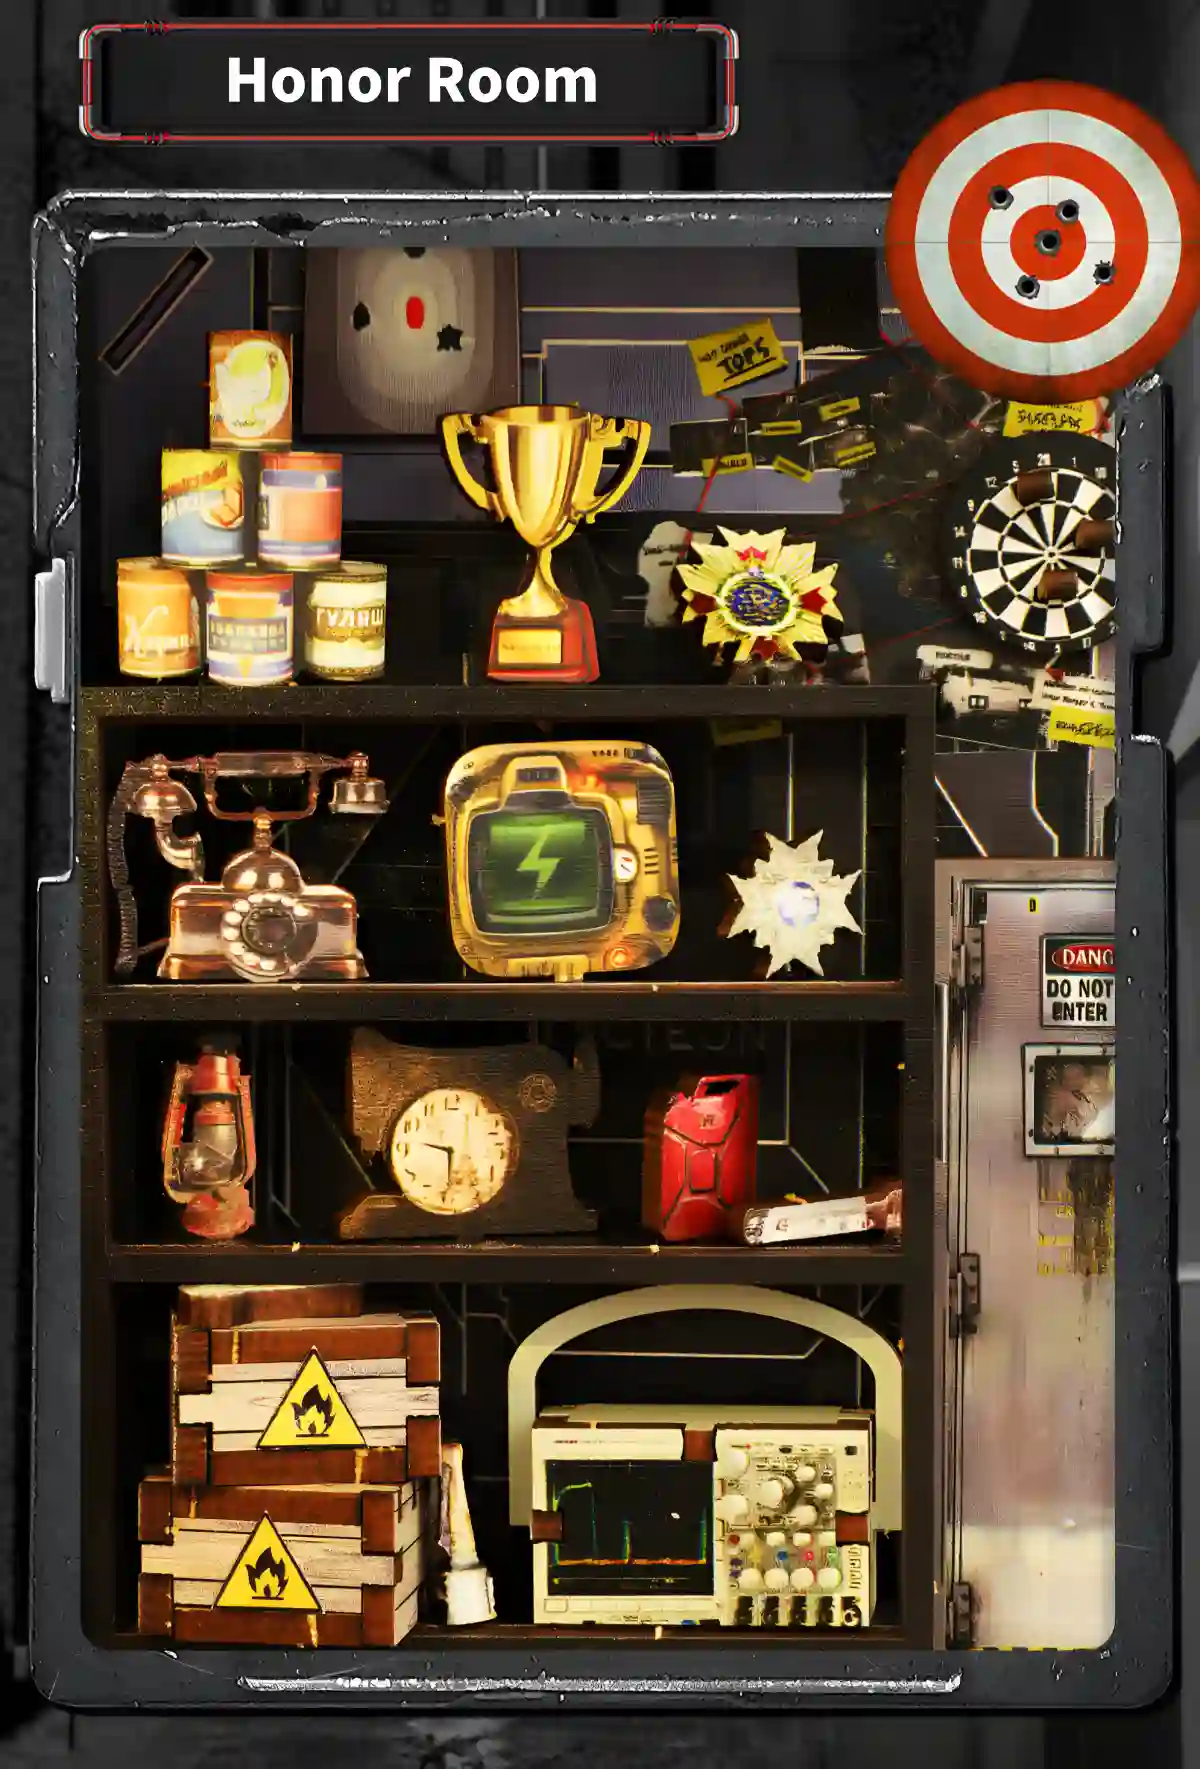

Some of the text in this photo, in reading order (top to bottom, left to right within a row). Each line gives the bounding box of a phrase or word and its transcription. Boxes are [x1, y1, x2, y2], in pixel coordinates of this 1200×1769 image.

[1046, 979, 1114, 998] DO NOT
[1051, 1001, 1108, 1022] ENTER
